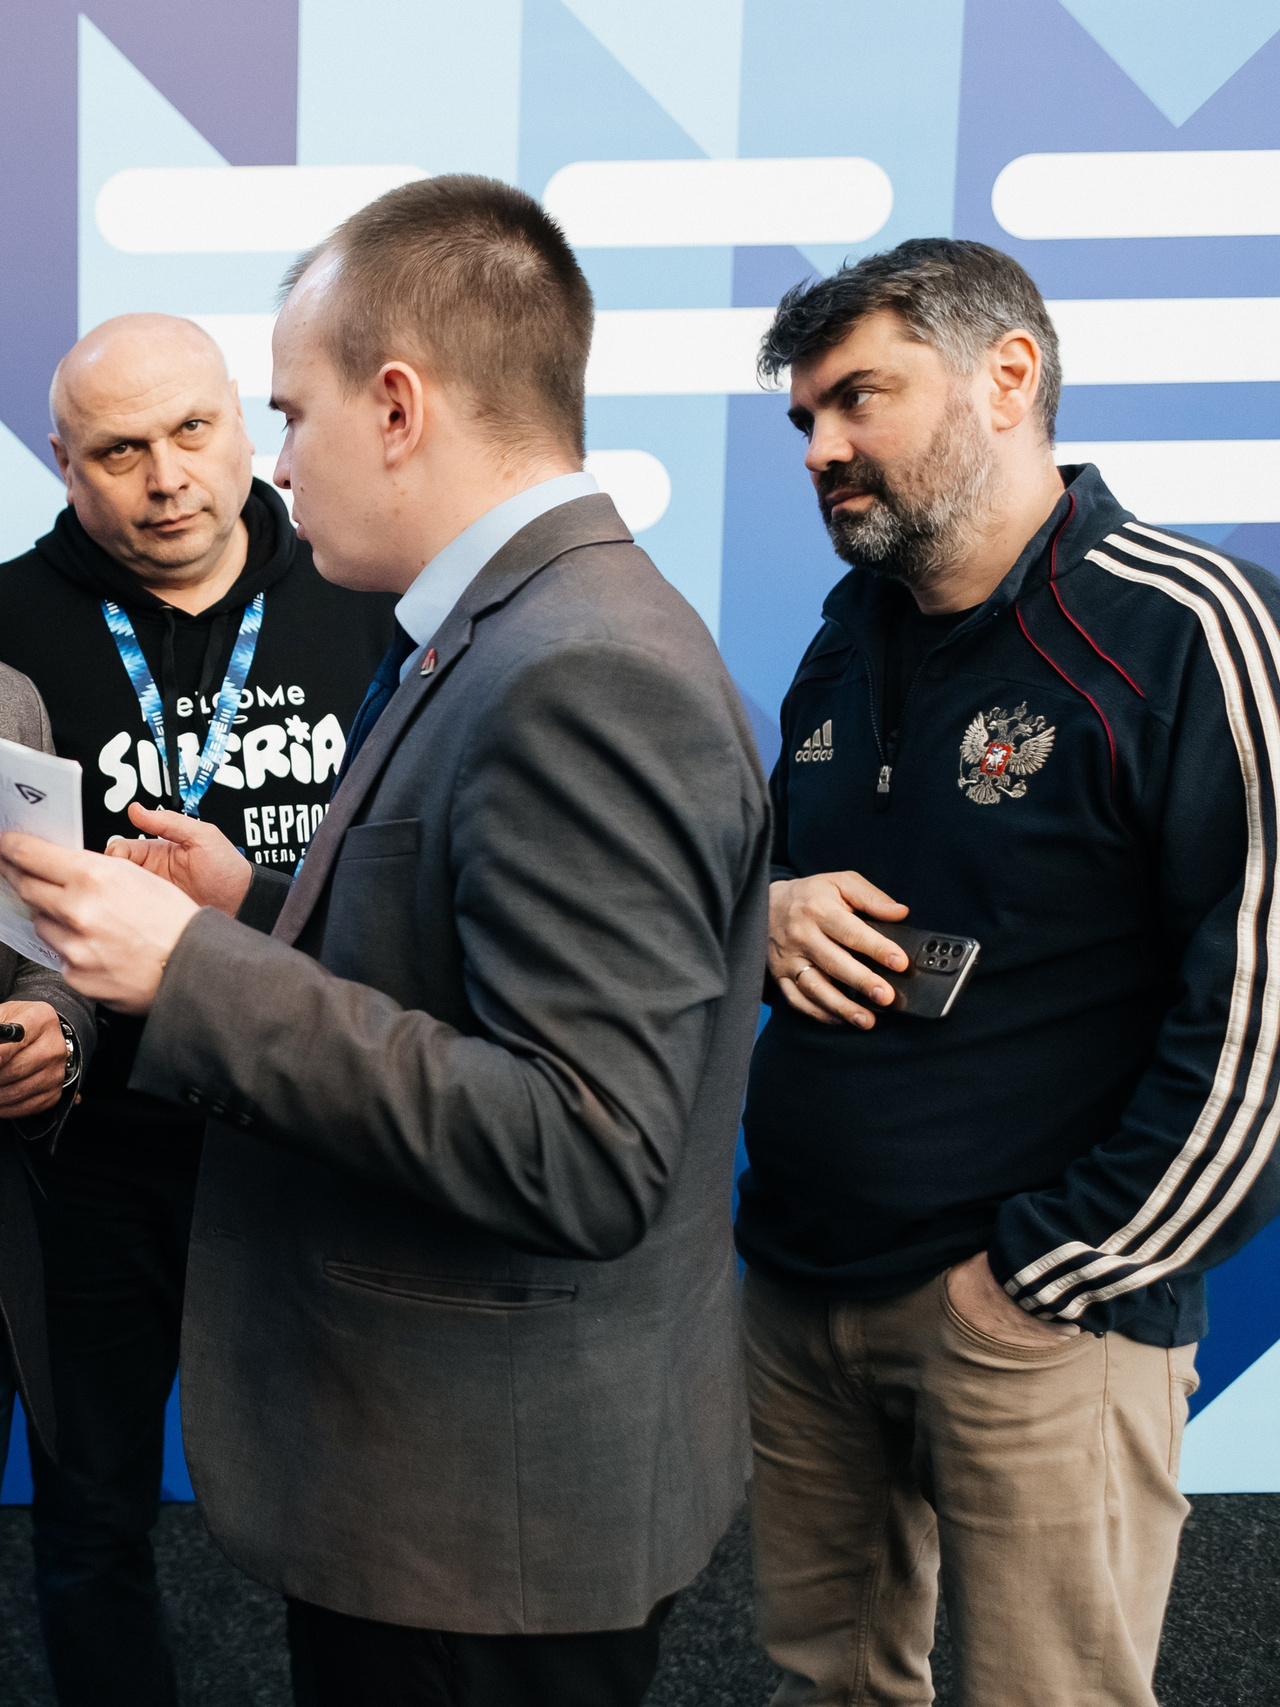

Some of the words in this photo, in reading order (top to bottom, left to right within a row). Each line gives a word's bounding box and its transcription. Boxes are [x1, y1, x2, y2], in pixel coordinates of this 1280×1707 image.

[795, 748, 834, 762] adidas
[243, 803, 330, 847] БЕРЛО
[254, 848, 296, 865] ОТЕЛЬ
